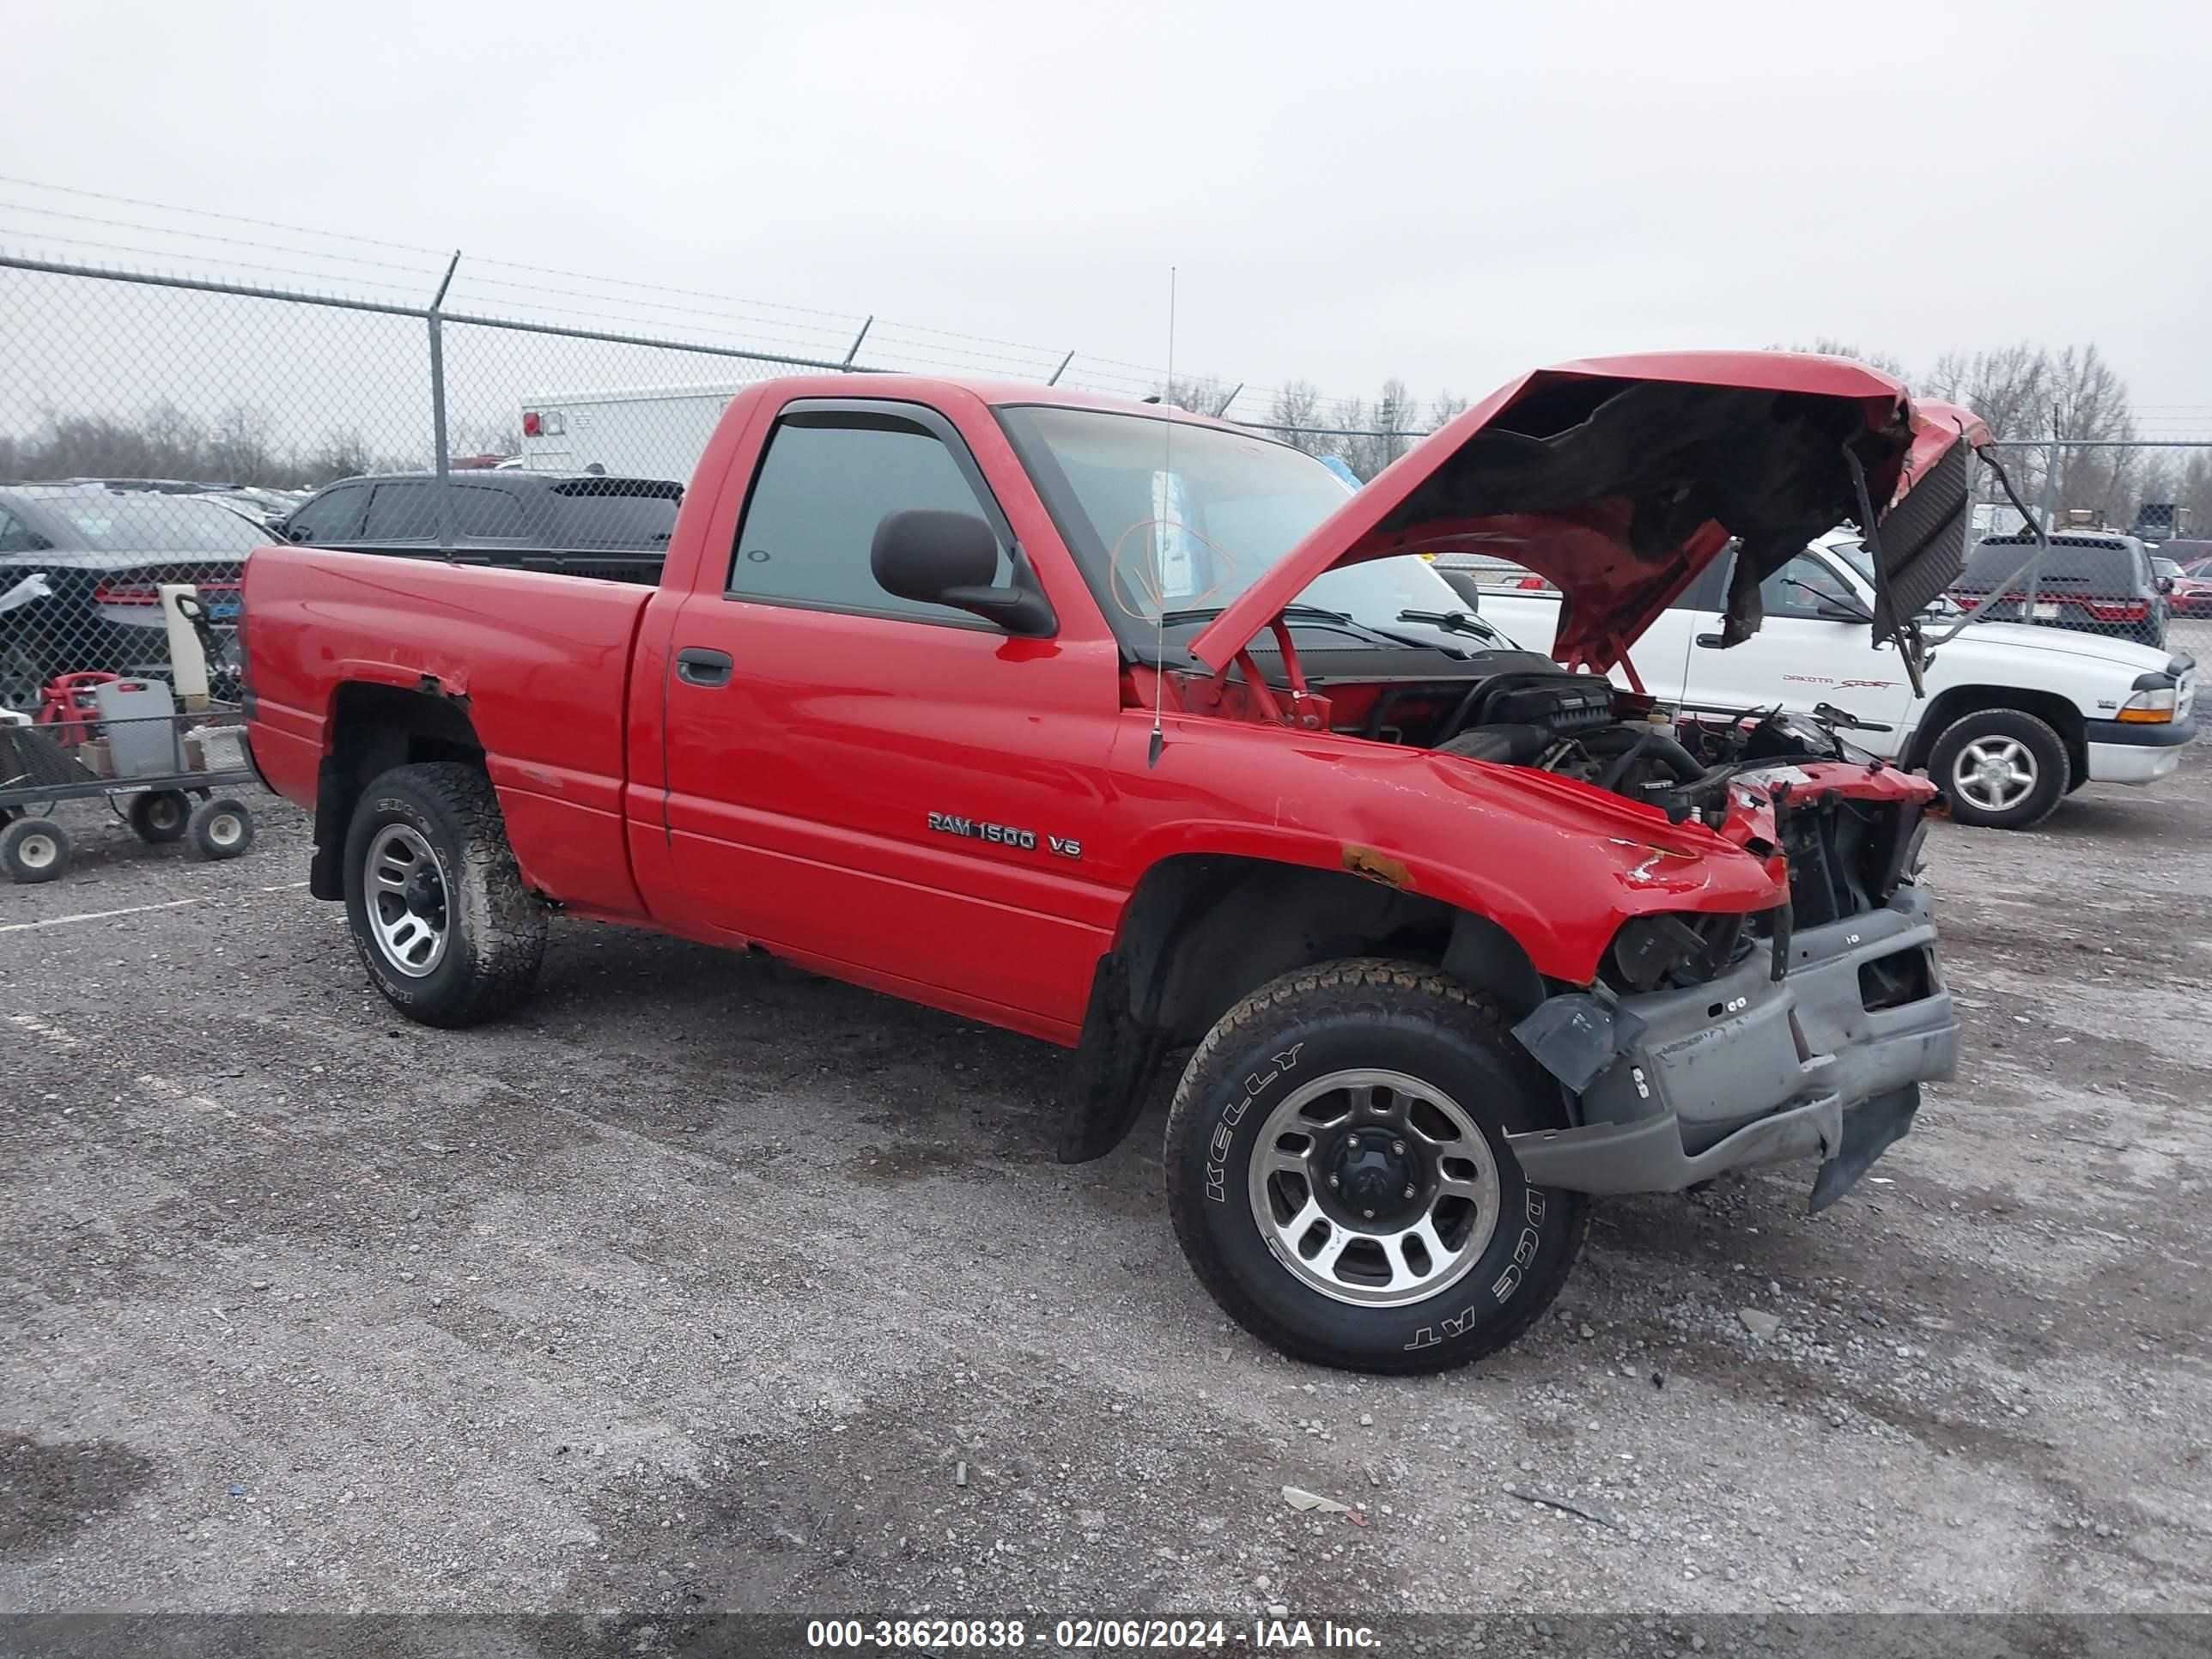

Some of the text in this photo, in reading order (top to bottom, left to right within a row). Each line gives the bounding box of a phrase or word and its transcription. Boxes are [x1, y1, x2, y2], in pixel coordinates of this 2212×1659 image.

[1783, 674, 1834, 684] DAKOTA
[927, 811, 1036, 850] RAM 1500
[1048, 834, 1081, 857] V6
[1206, 1042, 1305, 1203] KELLY
[1403, 1171, 1547, 1351] DGE AT
